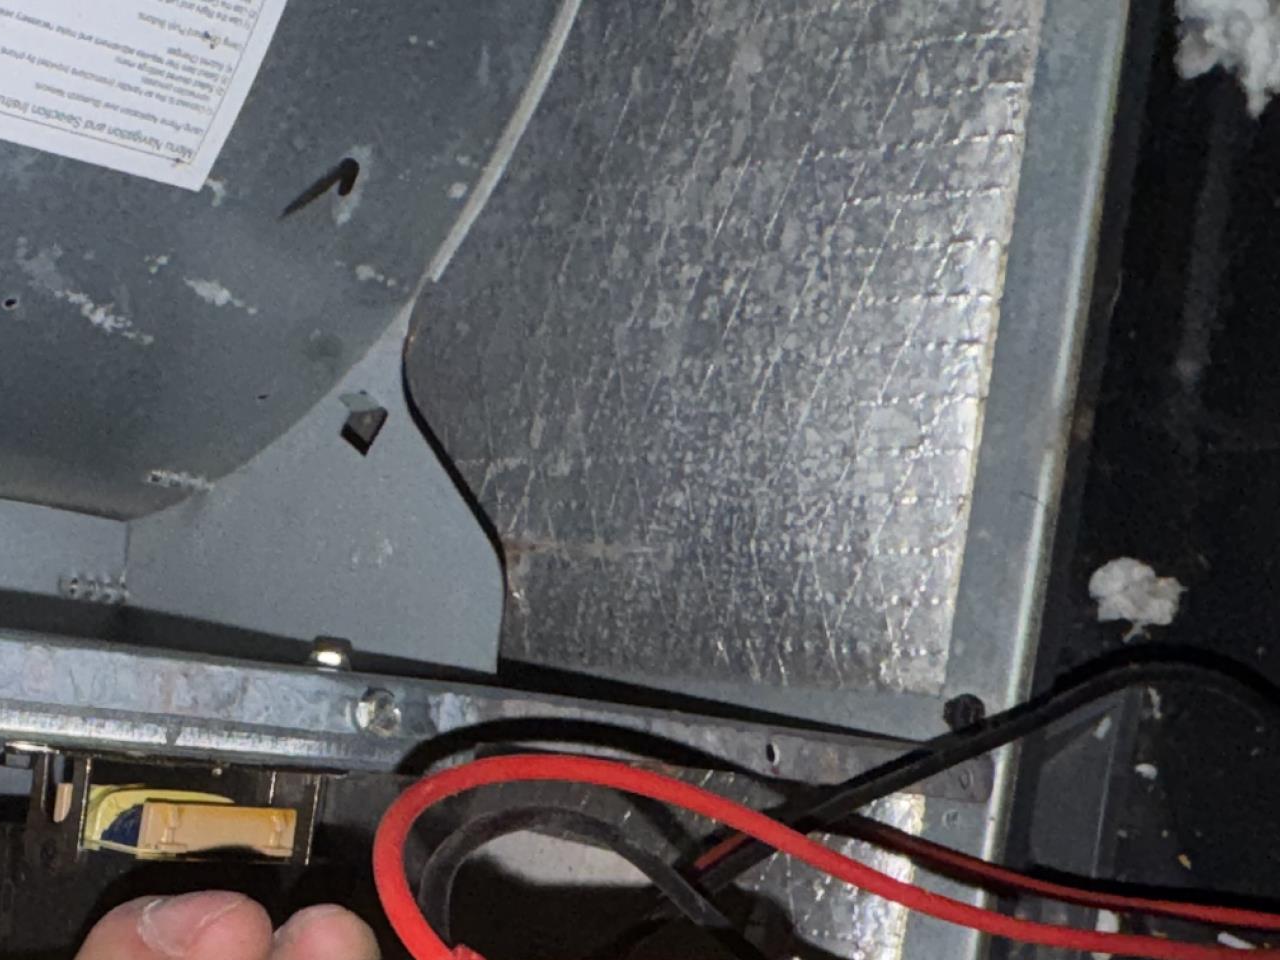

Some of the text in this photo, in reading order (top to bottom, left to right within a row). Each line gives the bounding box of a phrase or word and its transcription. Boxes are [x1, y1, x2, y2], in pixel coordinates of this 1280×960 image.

[29, 102, 82, 127] Selection
[82, 117, 107, 134] and
[106, 122, 164, 149] Navigation
[163, 139, 194, 158] Menu
